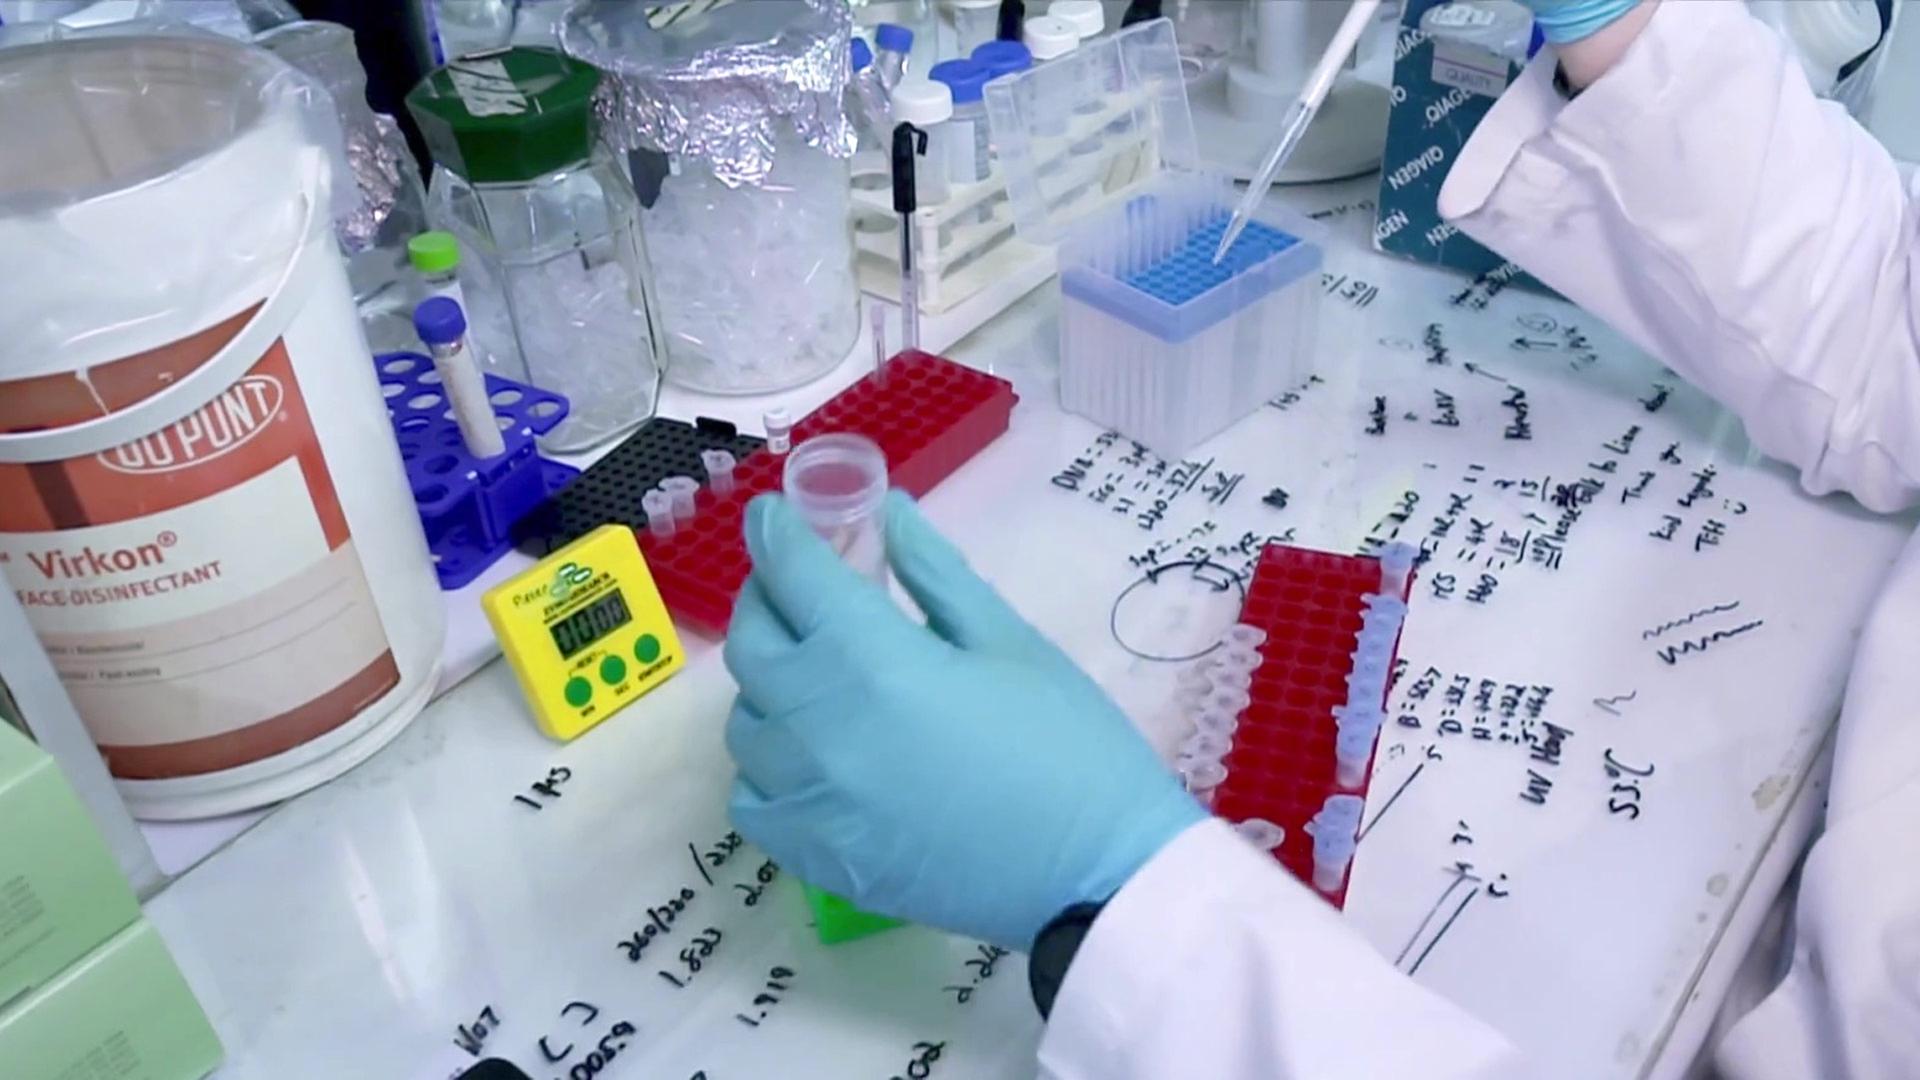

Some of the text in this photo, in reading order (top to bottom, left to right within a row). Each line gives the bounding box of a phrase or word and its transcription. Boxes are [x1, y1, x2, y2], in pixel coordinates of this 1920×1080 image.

[1425, 85, 1471, 124] QIAGE
[1387, 145, 1444, 190] QIAGEN
[70, 561, 223, 606] DISINFECTANT
